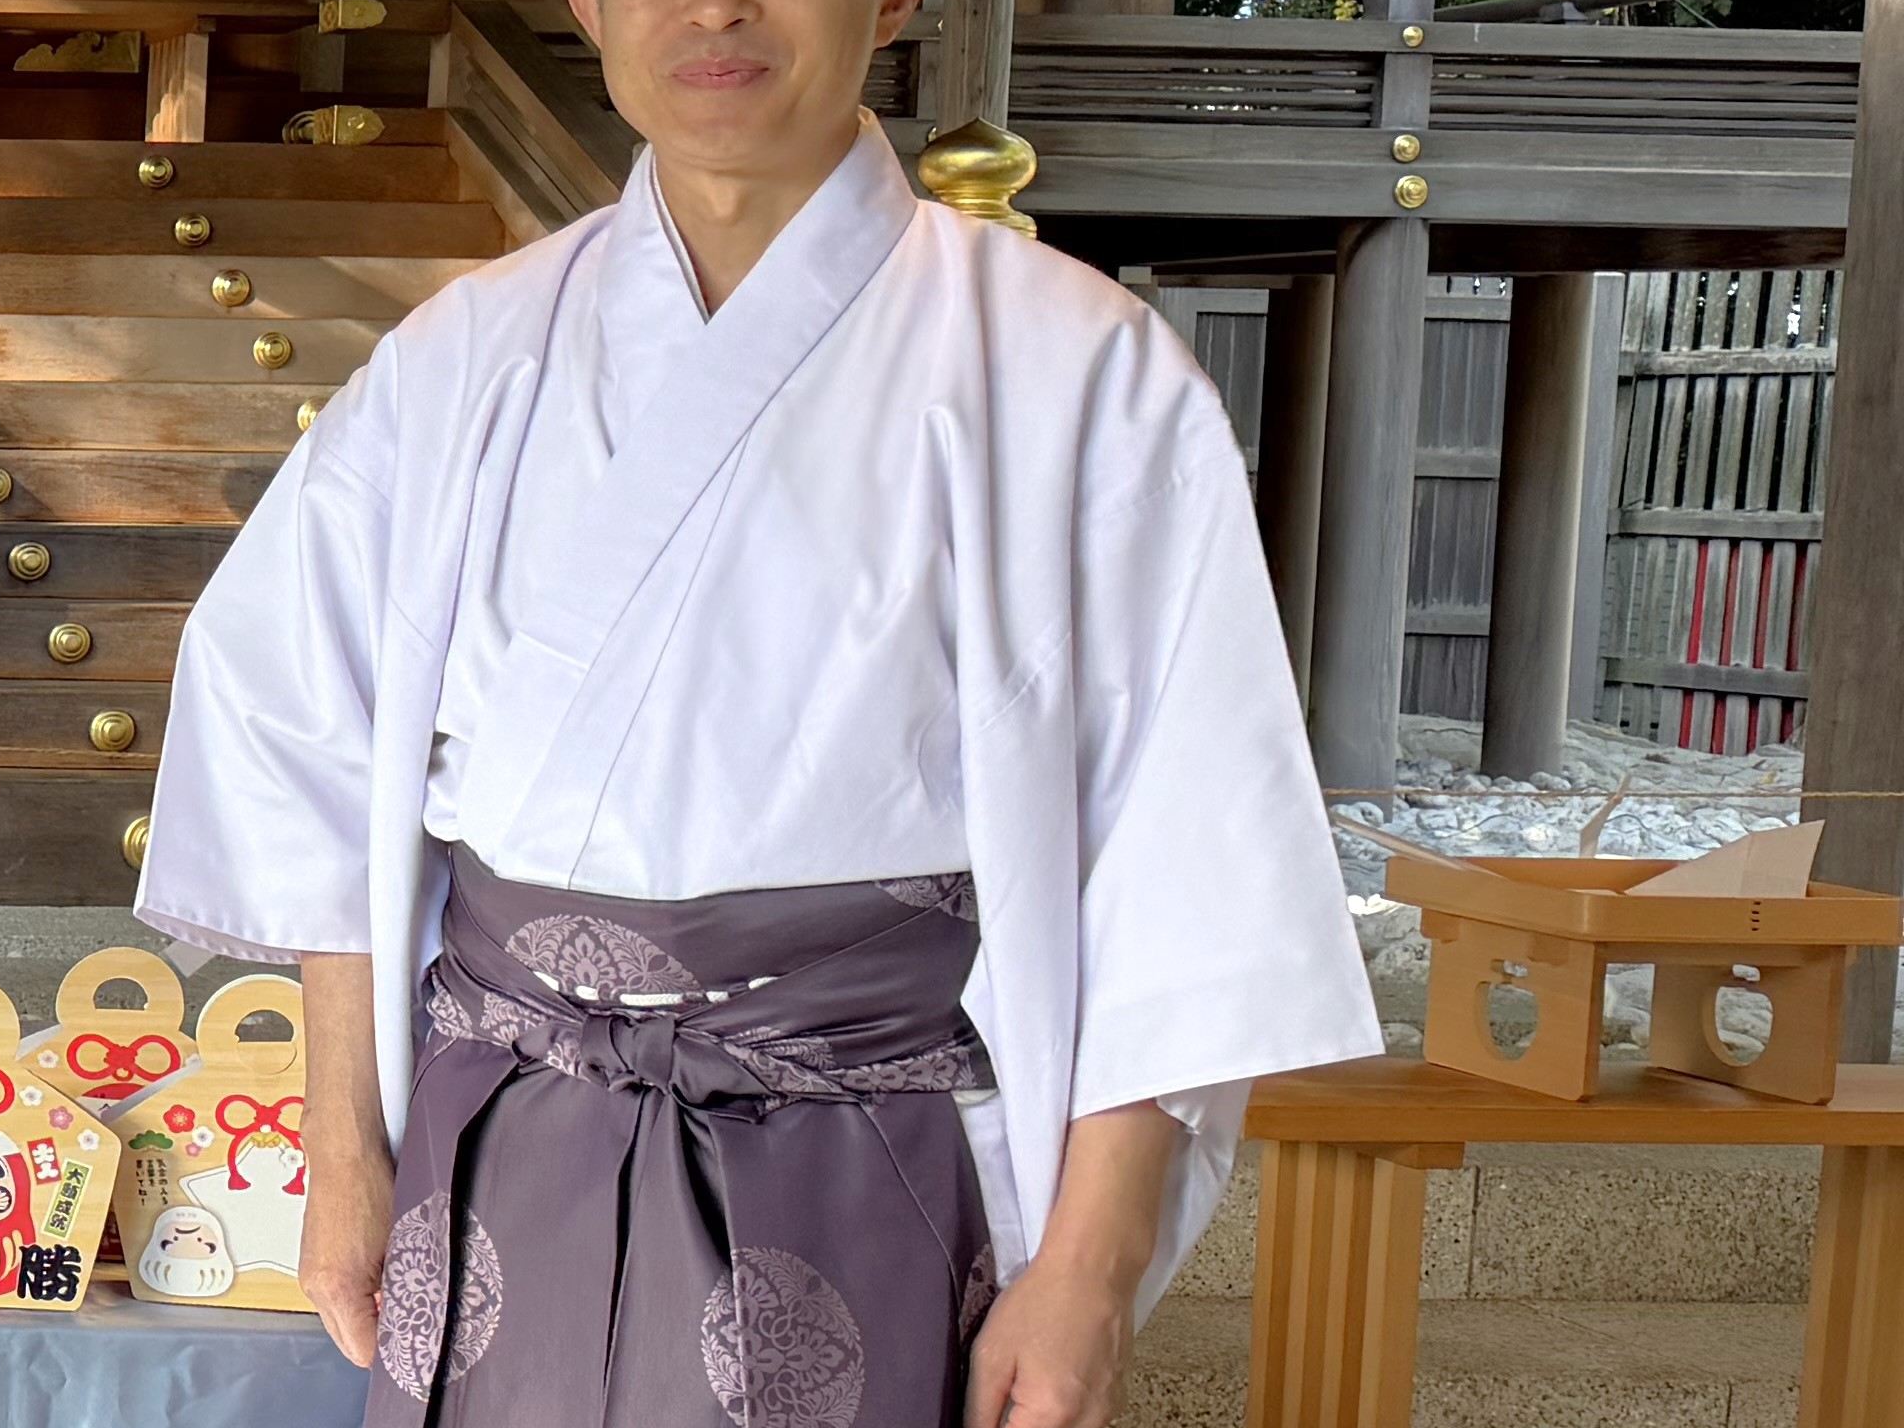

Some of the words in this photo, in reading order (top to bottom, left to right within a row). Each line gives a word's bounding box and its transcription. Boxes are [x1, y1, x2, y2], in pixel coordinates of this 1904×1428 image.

[31, 1143, 58, 1180] 大入
[50, 1168, 85, 1231] 大願成就
[17, 1244, 82, 1301] 勝
